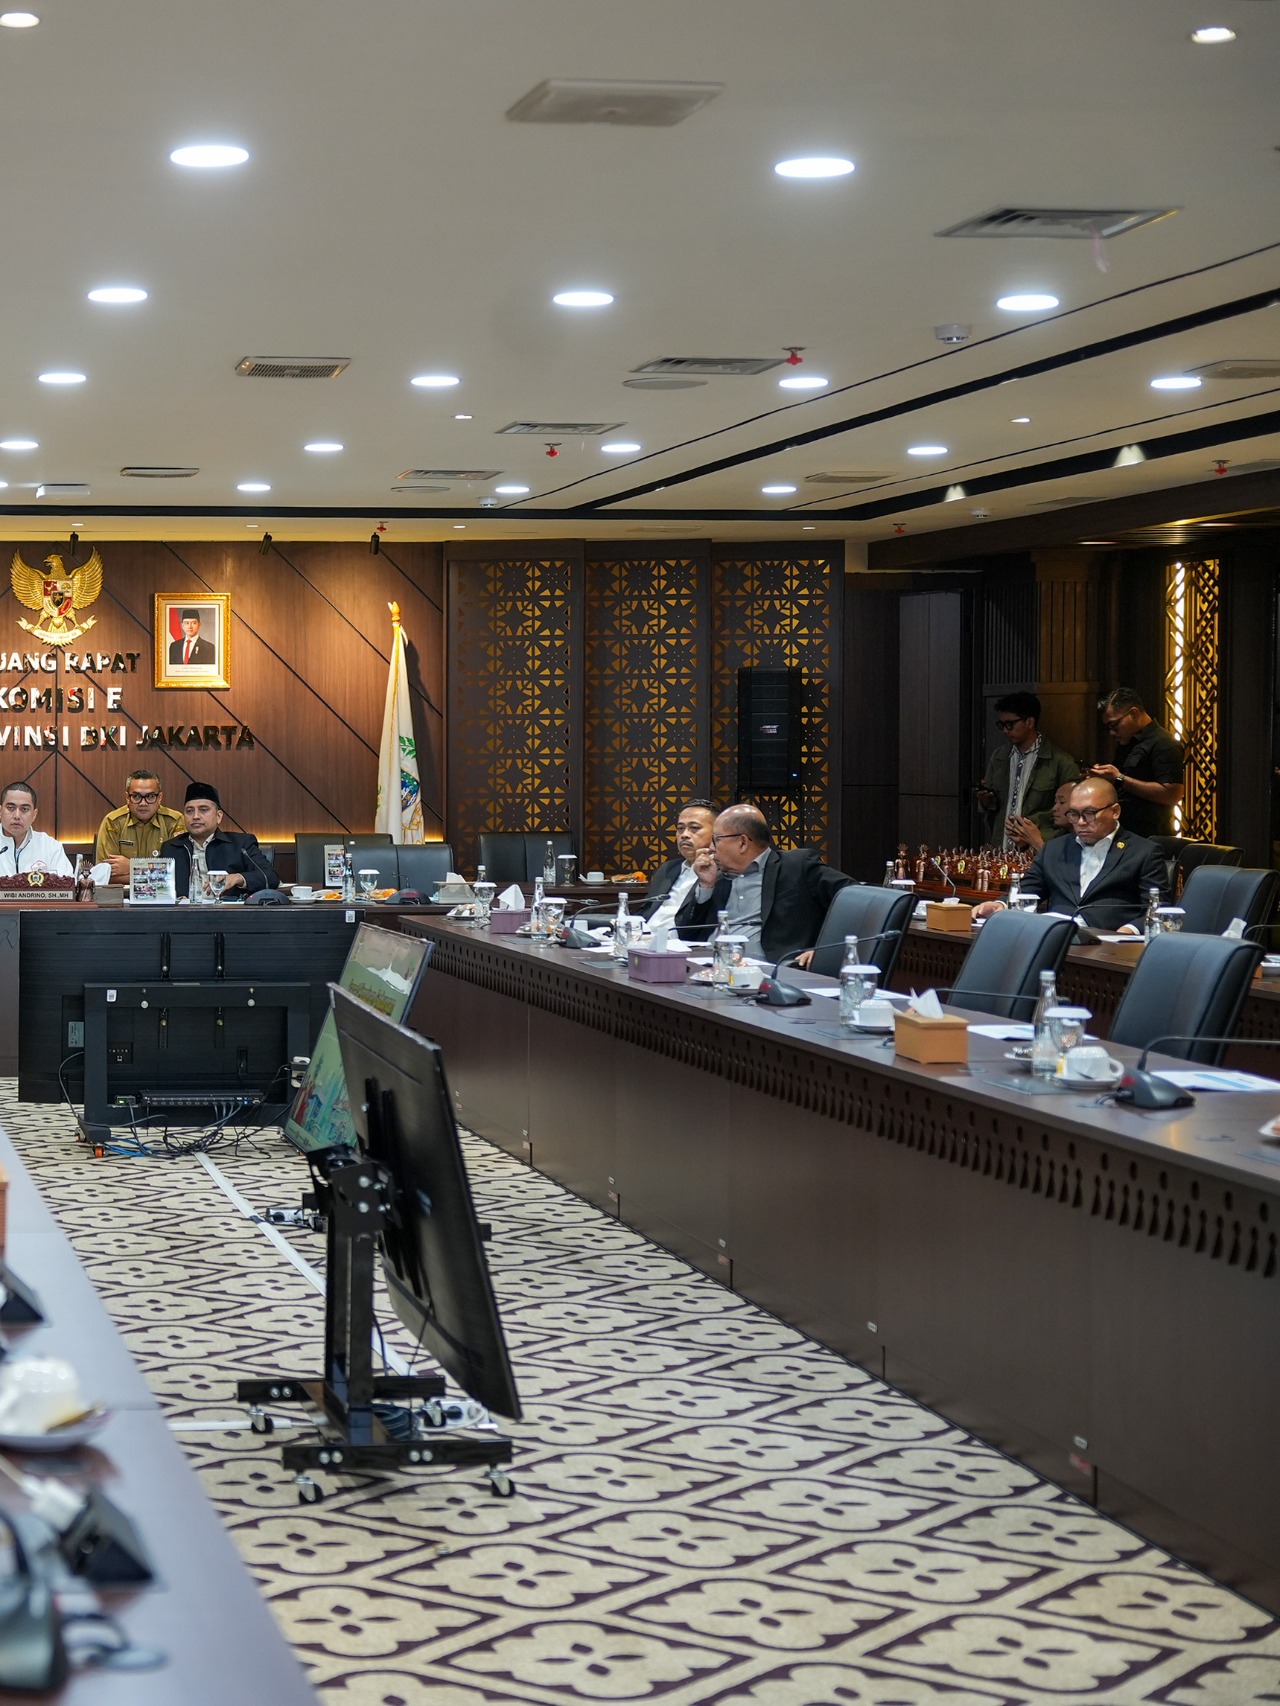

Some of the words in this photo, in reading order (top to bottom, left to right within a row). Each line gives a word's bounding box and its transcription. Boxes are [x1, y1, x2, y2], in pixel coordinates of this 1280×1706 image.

[65, 652, 141, 673] RAPAT
[106, 687, 123, 713] E
[80, 725, 127, 750] DKI
[135, 725, 255, 750] JAKARTA
